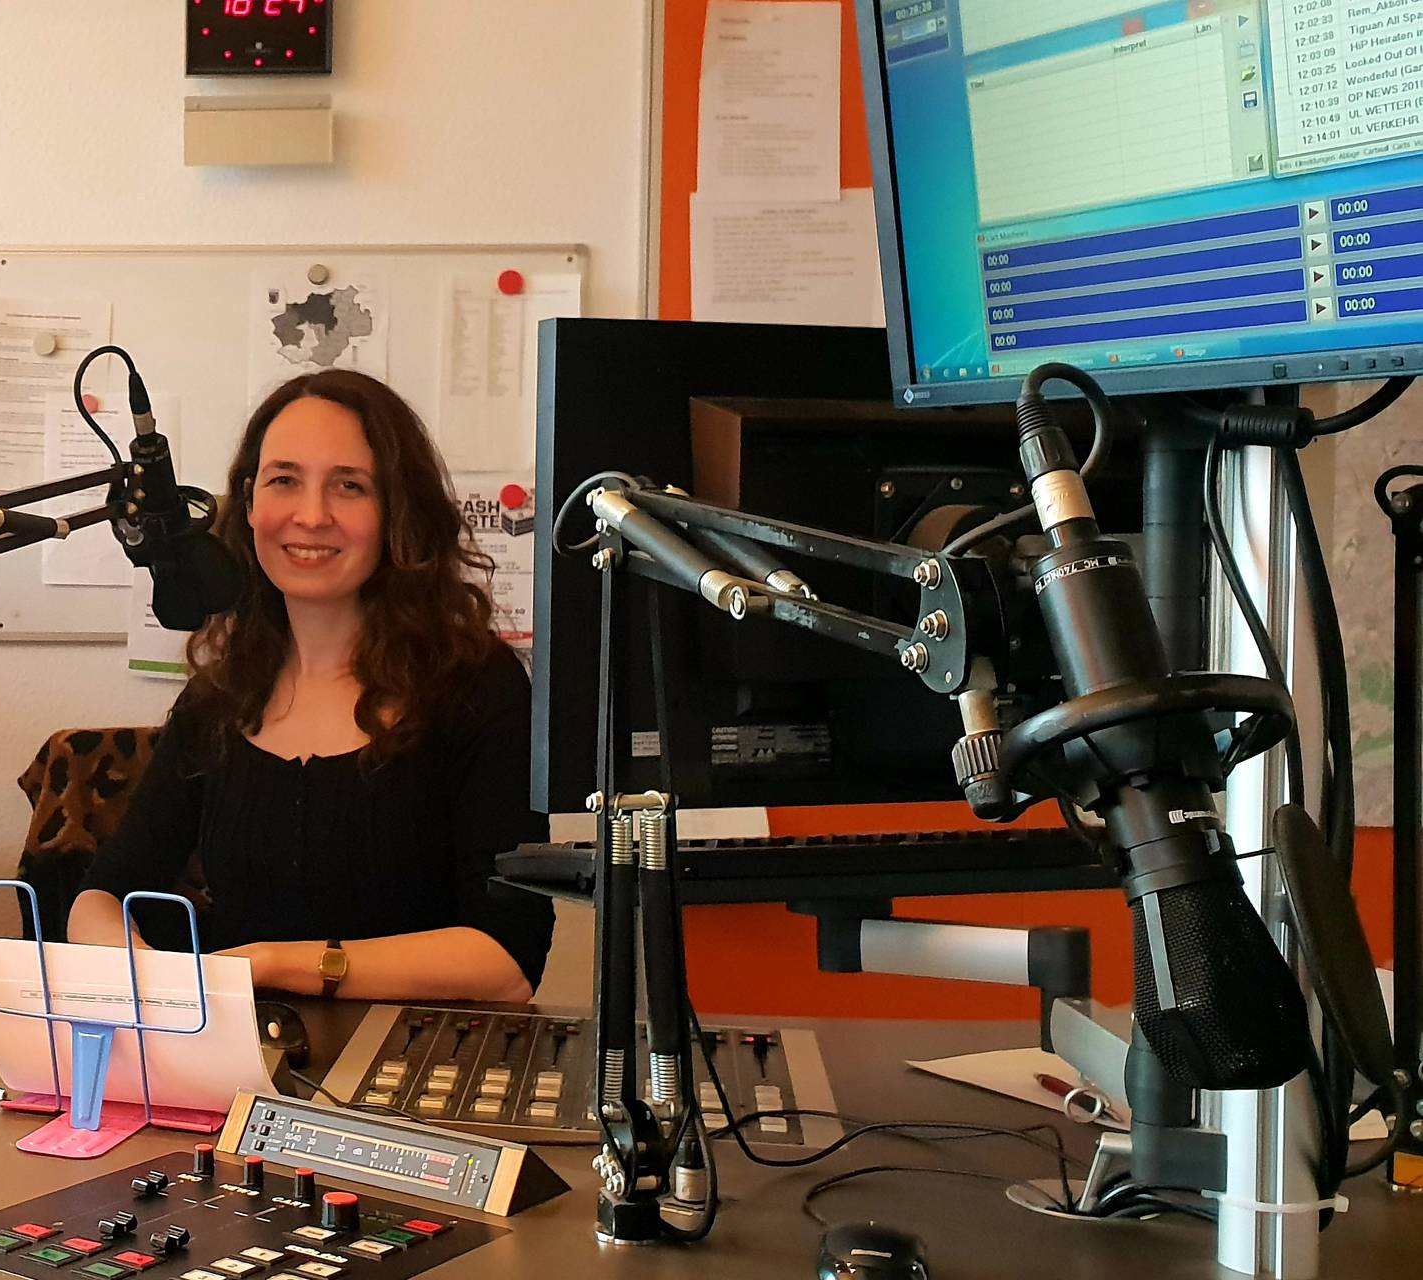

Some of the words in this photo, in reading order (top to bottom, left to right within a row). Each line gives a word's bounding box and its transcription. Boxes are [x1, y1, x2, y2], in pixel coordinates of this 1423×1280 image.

[1349, 21, 1383, 35] Tiguan
[1387, 16, 1399, 26] All
[1371, 32, 1413, 47] Heiraten
[1346, 53, 1381, 70] Locked
[1385, 50, 1402, 61] Out
[1406, 46, 1417, 56] Of
[1346, 67, 1397, 86] Wonderful
[1348, 91, 1363, 102] OP
[1366, 85, 1398, 99] NEWS
[1349, 110, 1362, 119] UL
[1365, 99, 1412, 116] WETTER
[1350, 126, 1363, 135] UL
[1366, 115, 1419, 132] VERKEHR
[1338, 200, 1368, 215] 00:00
[1340, 233, 1370, 247] 00:00
[987, 254, 1009, 267] 00:00
[1342, 265, 1373, 280] 00:00
[990, 281, 1011, 294] 00:00
[1345, 297, 1375, 311] 00:00
[993, 308, 1014, 320] 00:00
[995, 335, 1017, 347] 00:00
[457, 500, 500, 513] ASH
[1083, 559, 1099, 570] MC
[272, 1197, 311, 1208] CART
